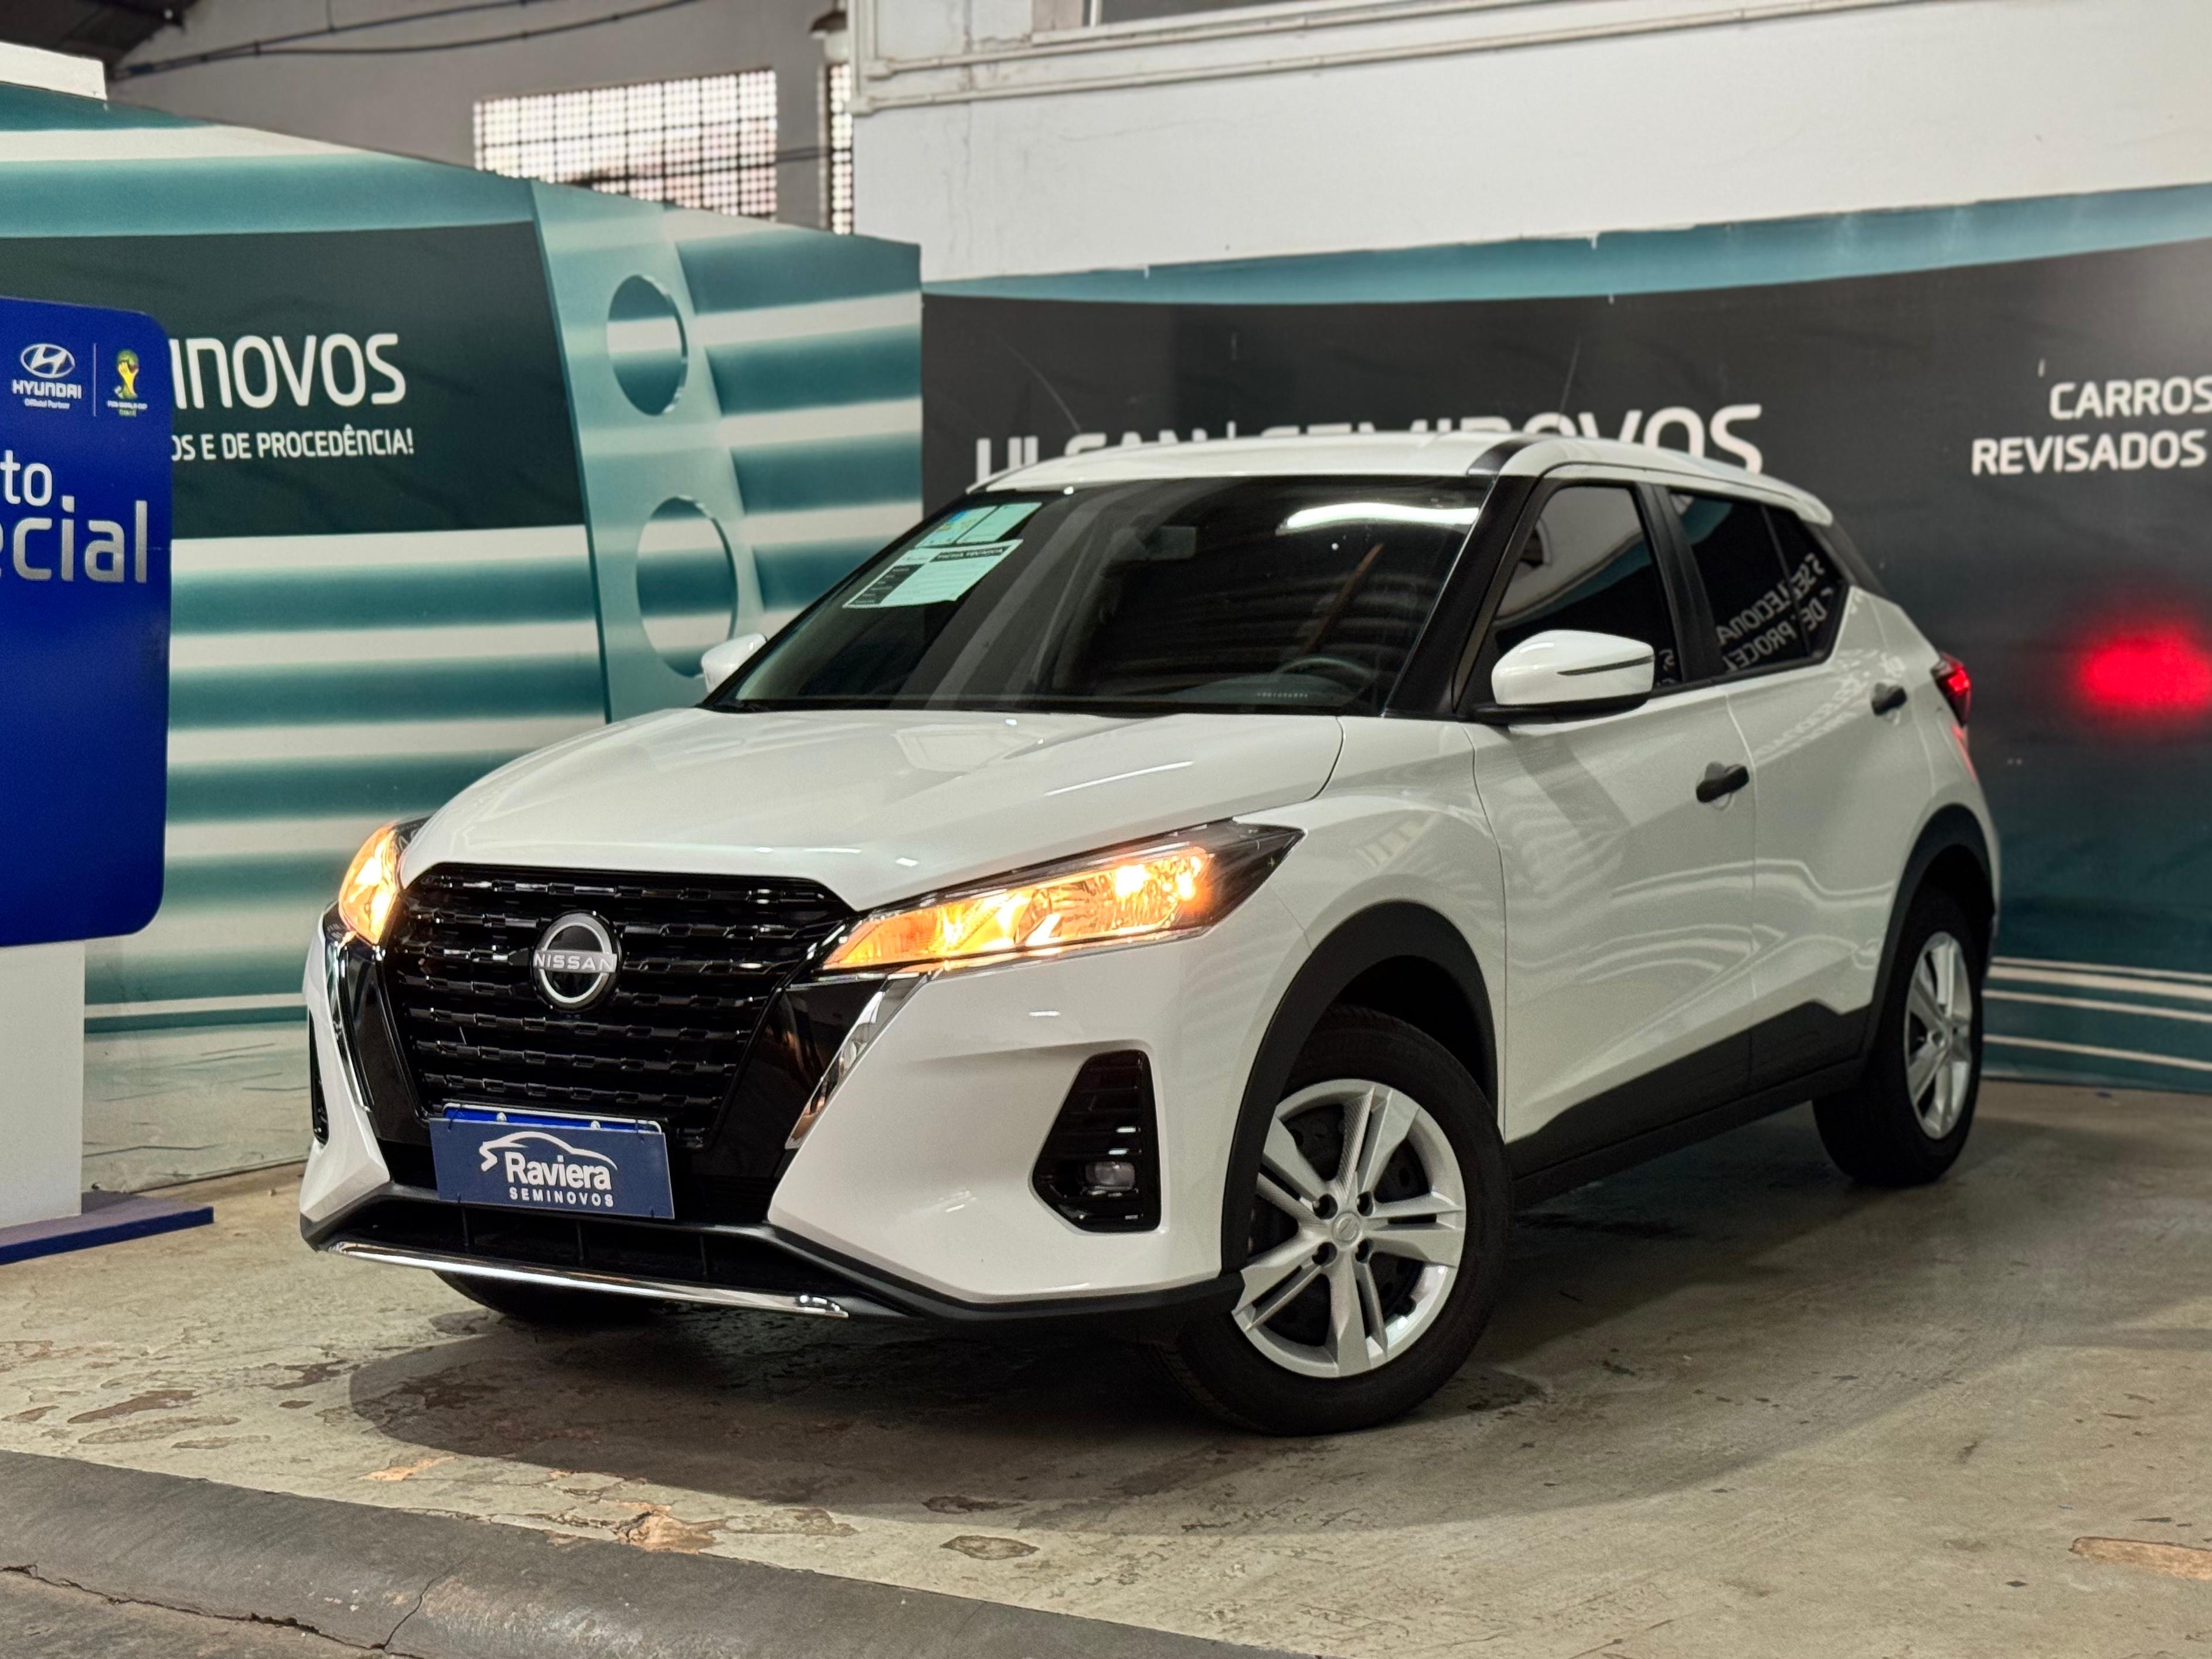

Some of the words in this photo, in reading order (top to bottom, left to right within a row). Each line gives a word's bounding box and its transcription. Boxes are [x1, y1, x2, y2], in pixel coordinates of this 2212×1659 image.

[12, 379, 81, 399] HYUNDAI
[2049, 375, 2212, 420] CARROS
[200, 434, 217, 460] E
[221, 432, 252, 459] DE
[256, 423, 414, 458] PROCEDÊNCIA!
[1972, 429, 2207, 476] REVISADOS
[0, 449, 53, 507] to
[0, 495, 148, 584] cial
[534, 953, 615, 971] NISSAN
[505, 1152, 611, 1190] Raviera
[509, 1187, 614, 1208] SEMINOVOS
